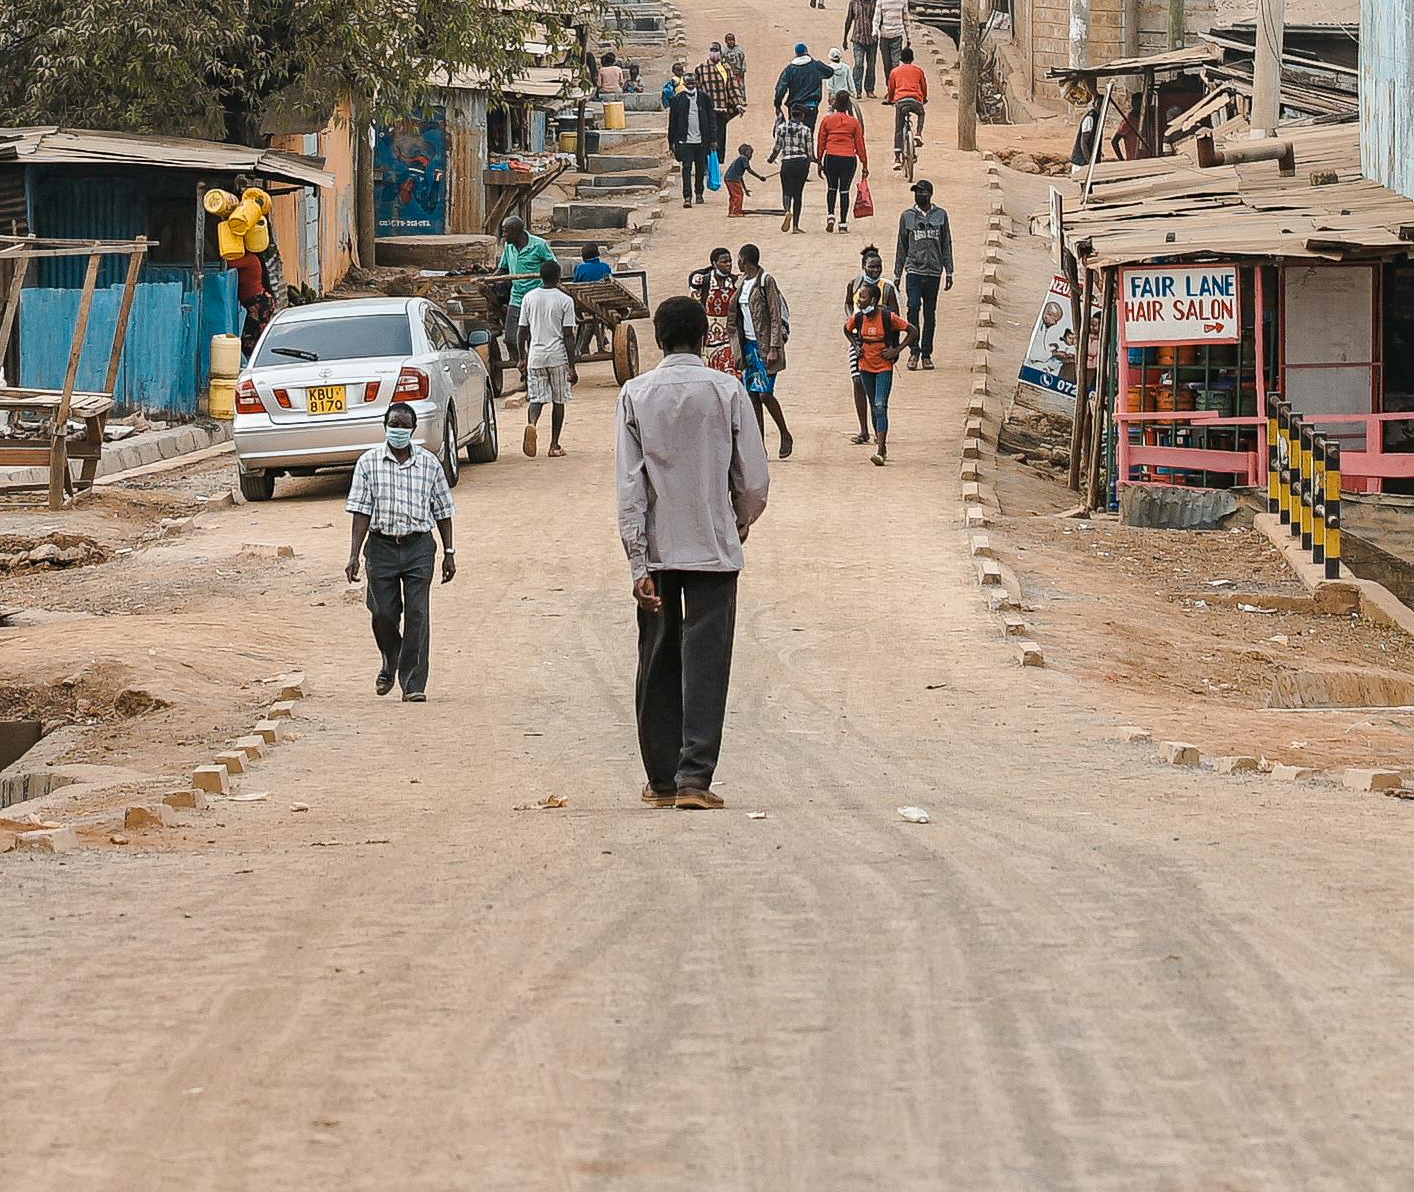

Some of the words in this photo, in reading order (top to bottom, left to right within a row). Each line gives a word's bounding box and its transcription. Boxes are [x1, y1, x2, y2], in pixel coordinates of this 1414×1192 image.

[1130, 276, 1176, 298] FAIR
[1186, 274, 1235, 297] LANE
[1124, 300, 1165, 322] HAIR
[1173, 299, 1234, 321] SALON
[309, 387, 334, 401] KBU
